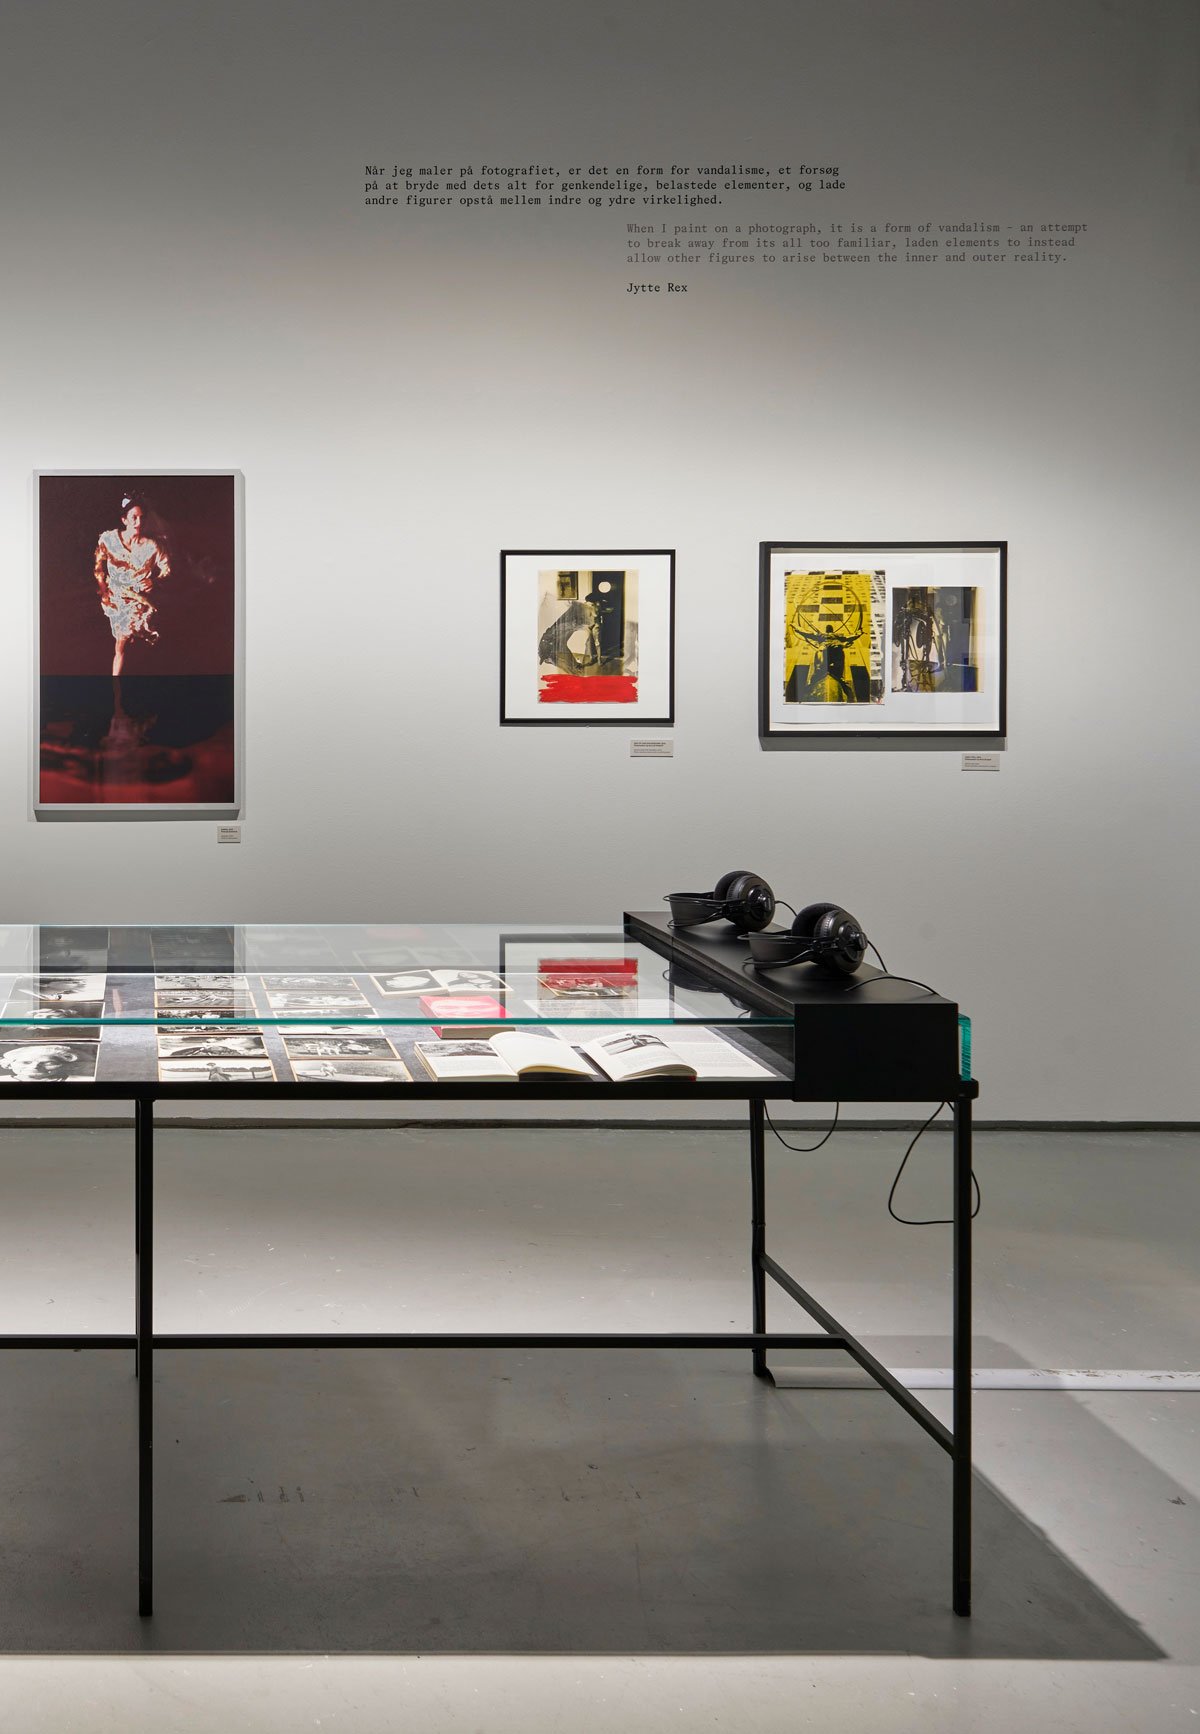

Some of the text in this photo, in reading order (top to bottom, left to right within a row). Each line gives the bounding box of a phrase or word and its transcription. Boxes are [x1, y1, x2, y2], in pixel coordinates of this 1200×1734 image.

[365, 166, 385, 175] Når
[392, 166, 412, 177] jeg
[419, 166, 453, 175] maler
[460, 166, 473, 177] på
[481, 164, 559, 177] fotografiet,
[588, 165, 608, 175] det
[637, 165, 663, 175] form
[671, 165, 690, 175] for
[697, 165, 769, 177] vandalisme,
[778, 166, 791, 174] et
[800, 165, 839, 177] forsøg
[365, 179, 845, 192] på at bryde med dets alt for genkendelige, belastede elementer, og lade
[365, 194, 722, 208] andre figurer opstå mellem indre og ydre virkelighed.
[627, 224, 654, 233] When
[661, 224, 667, 233] I
[674, 224, 707, 235] paint
[749, 223, 821, 235] photograph,
[831, 224, 842, 232] it
[851, 223, 863, 232] is
[870, 225, 877, 233] a
[885, 223, 911, 232] form
[918, 223, 932, 232] of
[938, 222, 1000, 232] vandalism
[1041, 224, 1087, 234] attempt
[627, 240, 640, 248] to
[647, 238, 681, 248] break
[688, 240, 714, 250] away
[722, 238, 748, 247] from
[757, 238, 775, 247] its
[783, 238, 802, 247] all
[838, 237, 896, 249] familiar,
[905, 238, 938, 247] laden
[946, 237, 999, 247] elements
[1008, 238, 1020, 246] to
[1028, 237, 1075, 246] instead
[627, 252, 1066, 264] allow other figures to arise between the inner and outer reality.
[627, 282, 687, 294] Jytte Rex
